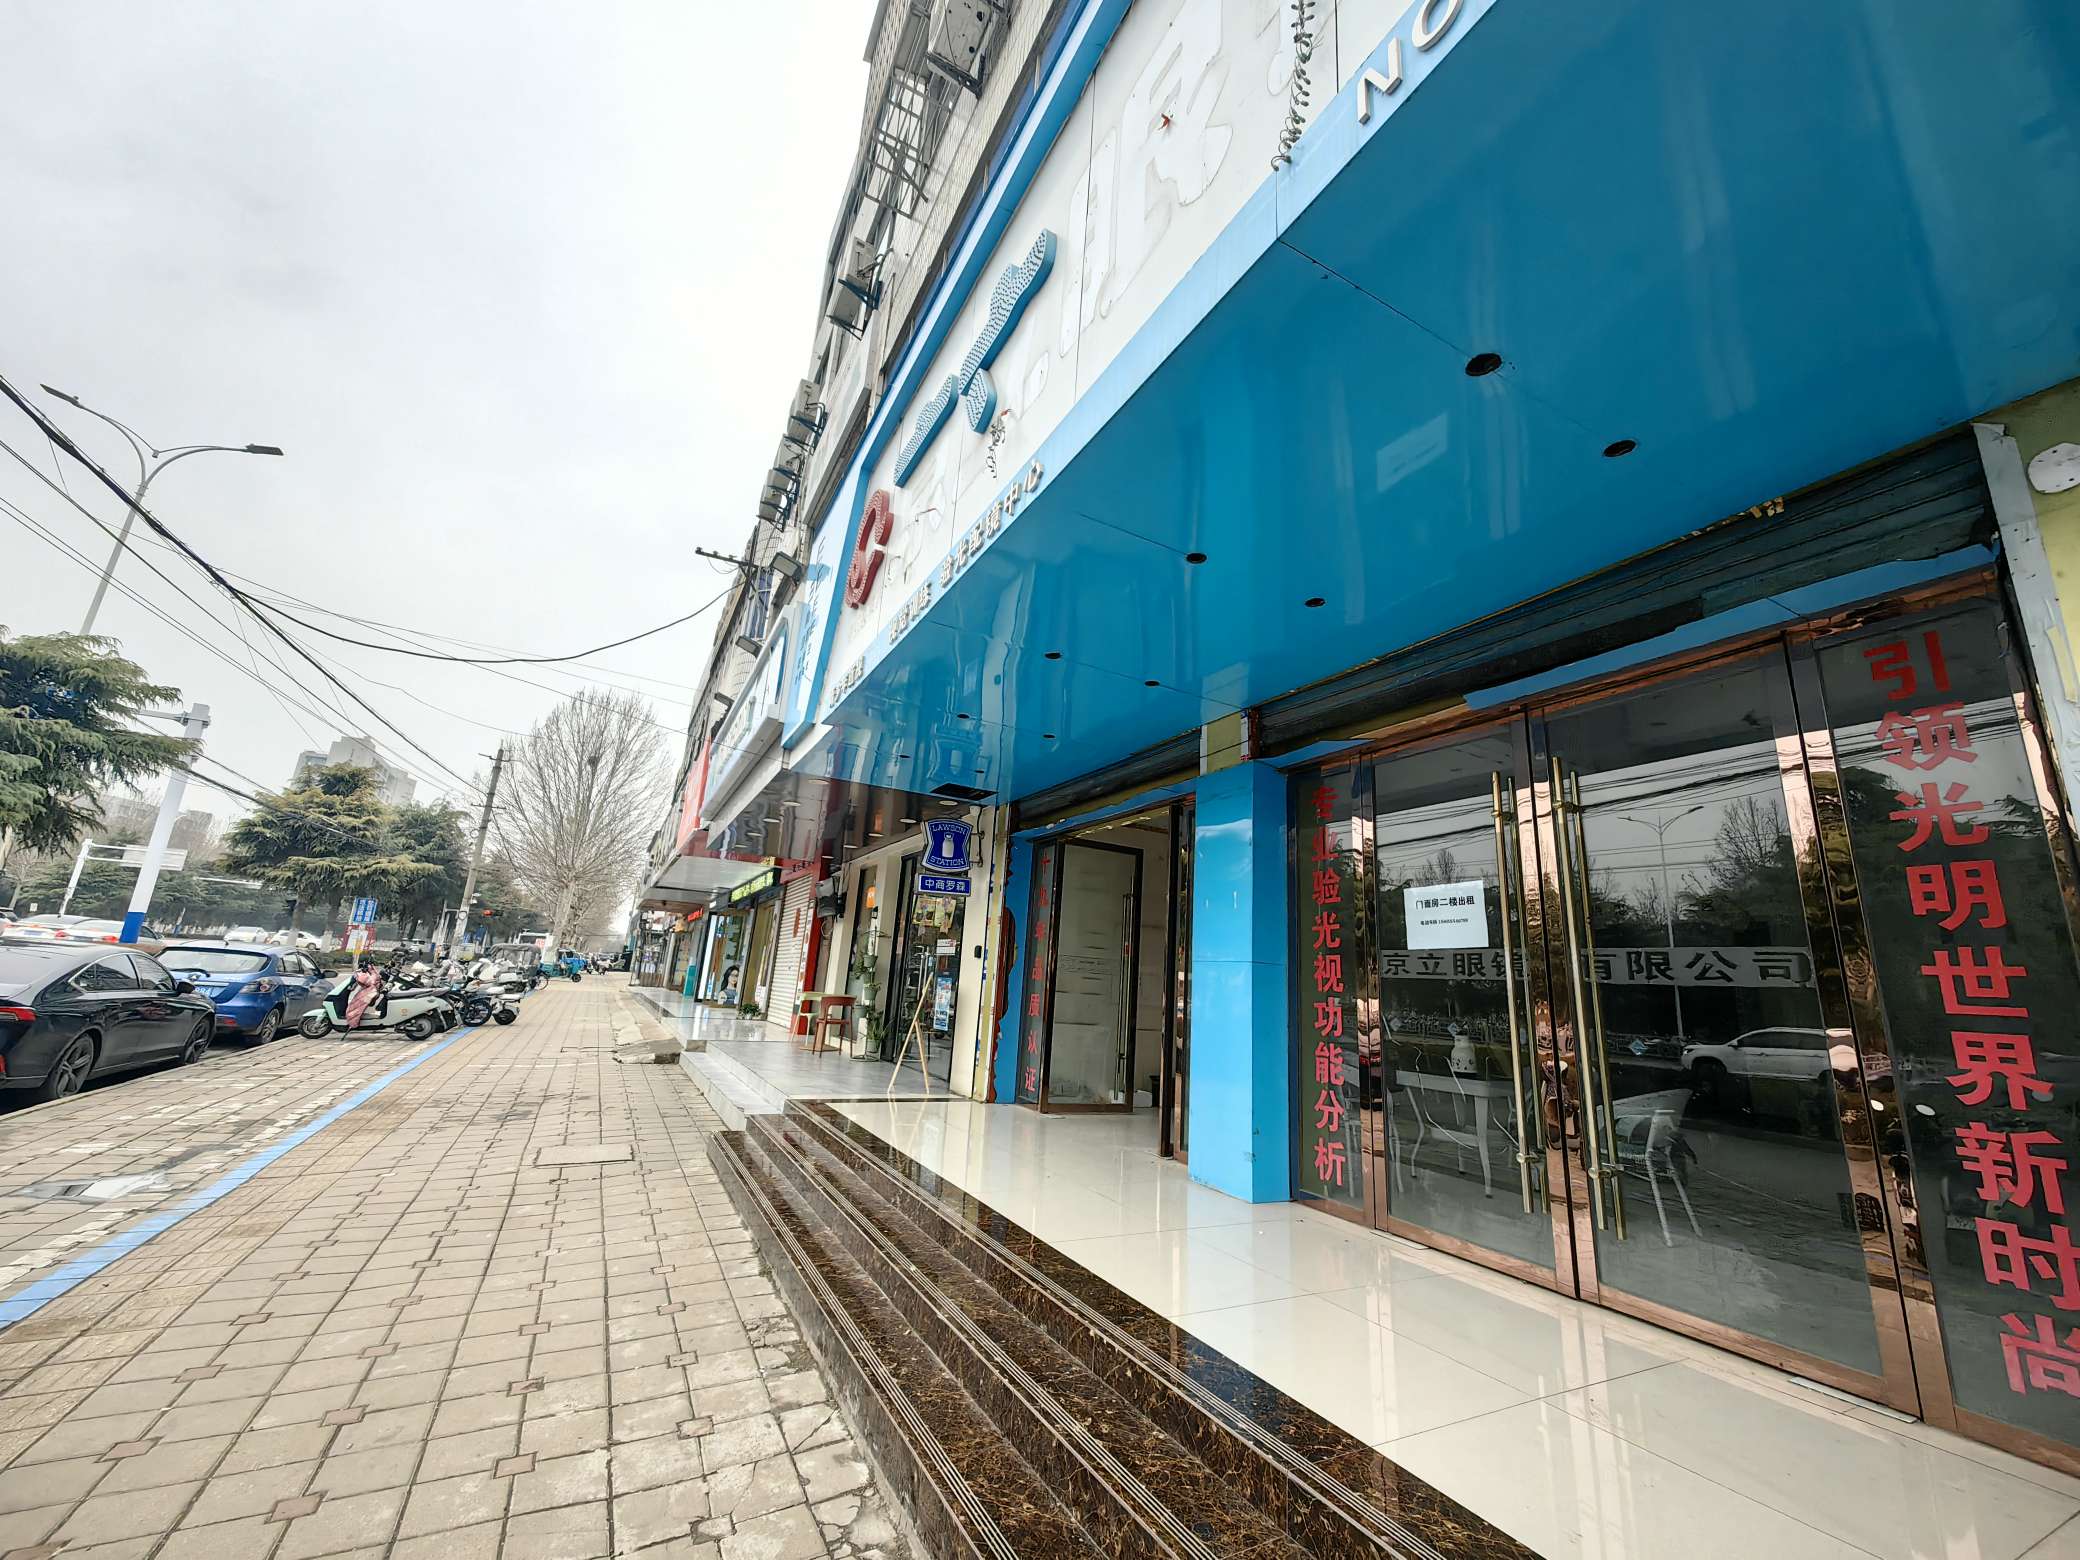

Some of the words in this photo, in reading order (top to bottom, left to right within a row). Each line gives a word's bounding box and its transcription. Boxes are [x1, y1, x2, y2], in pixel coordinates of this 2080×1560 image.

[932, 823, 966, 834] LAWSON
[930, 856, 964, 866] STATION
[925, 878, 965, 891] 中商罗森
[1416, 895, 1475, 910] 门面房二楼出租
[1311, 785, 1347, 1187] 专业验光视功能分析
[1864, 629, 2080, 1396] 引领光明世界新时尚
